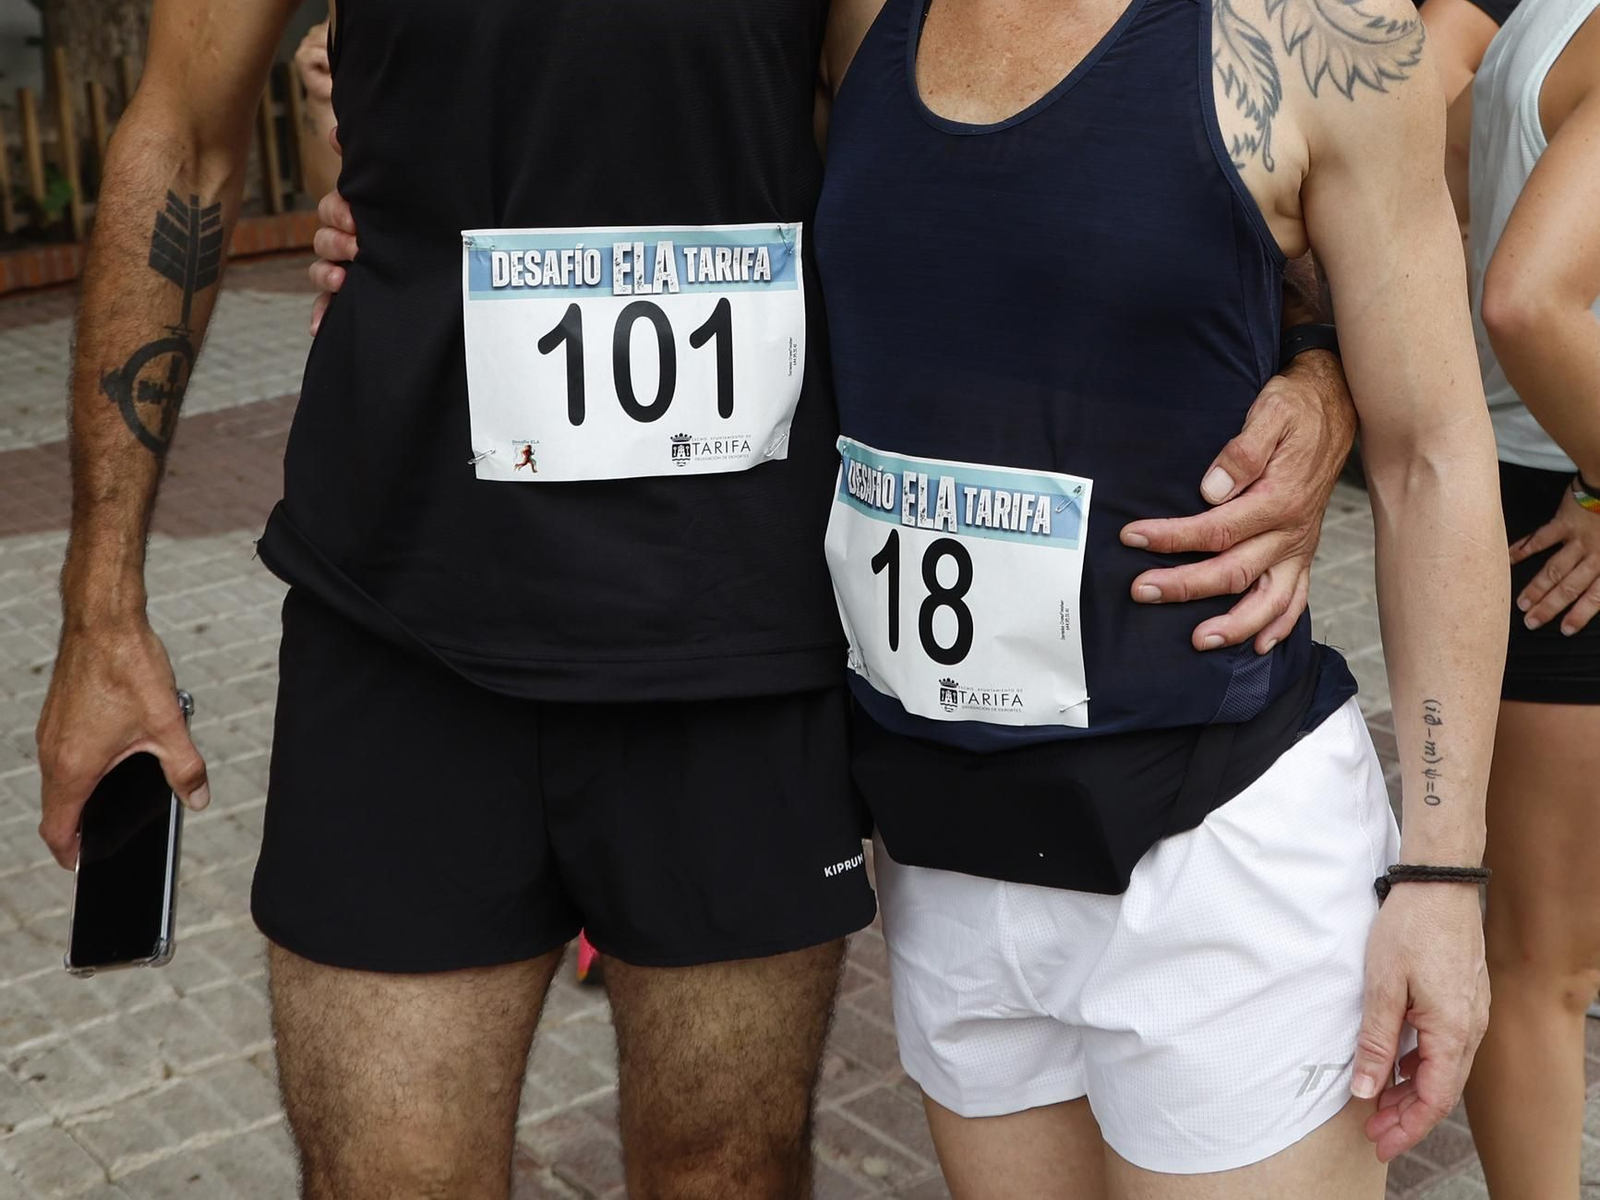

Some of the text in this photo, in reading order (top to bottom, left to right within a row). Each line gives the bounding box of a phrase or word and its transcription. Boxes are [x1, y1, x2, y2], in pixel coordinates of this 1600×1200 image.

[491, 240, 771, 295] DESAFÍO ELA TARIFA
[537, 297, 734, 426] 101
[692, 439, 751, 455] TARIFA
[848, 459, 1050, 535] DESAFÍO ELA TARIFA
[871, 528, 974, 666] 18
[958, 691, 1023, 706] TARIFA
